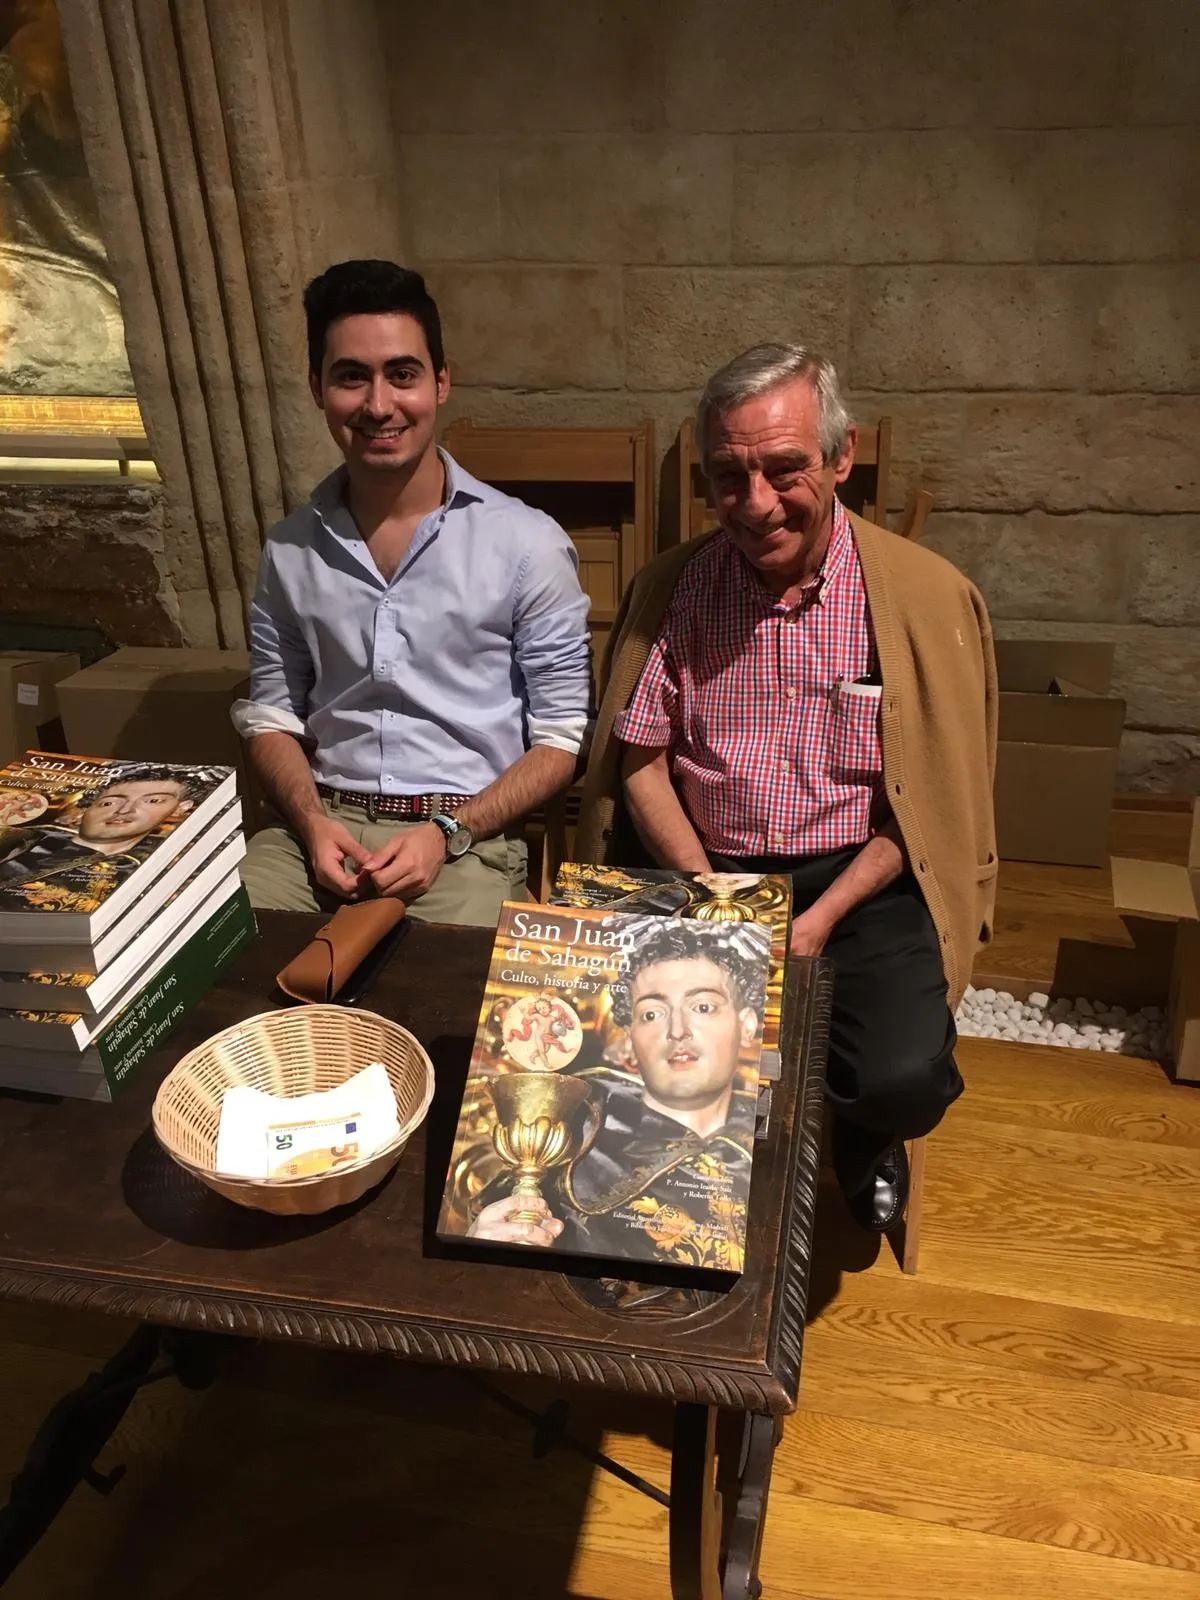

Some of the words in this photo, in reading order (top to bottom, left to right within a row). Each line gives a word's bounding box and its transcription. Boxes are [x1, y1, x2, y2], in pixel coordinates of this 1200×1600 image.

[10, 768, 33, 779] de
[23, 756, 65, 770] San
[70, 761, 123, 778] Juan
[510, 912, 561, 942] San
[569, 918, 635, 948] Juan
[505, 940, 532, 962] de
[537, 944, 632, 977] Sahagún
[163, 974, 177, 990] San
[501, 969, 540, 985] Culto,
[544, 973, 590, 990] historia
[592, 982, 602, 994] y
[603, 983, 628, 994] arte
[147, 985, 165, 1009] Juan
[171, 1001, 185, 1018] San
[155, 1012, 172, 1037] Juan
[276, 1134, 292, 1150] 50
